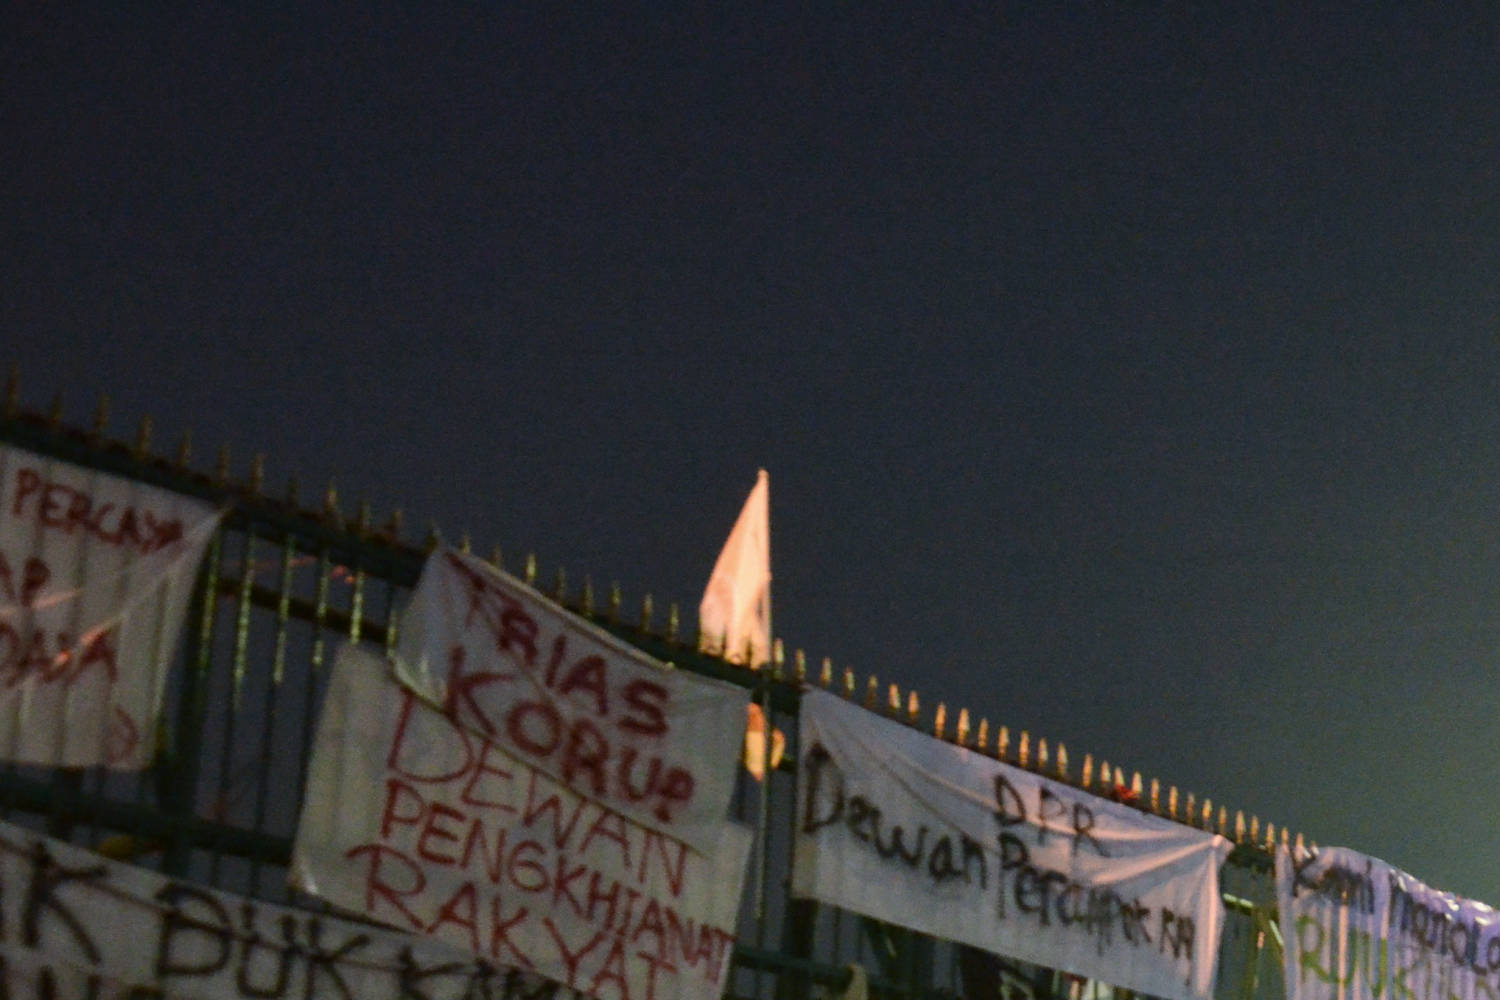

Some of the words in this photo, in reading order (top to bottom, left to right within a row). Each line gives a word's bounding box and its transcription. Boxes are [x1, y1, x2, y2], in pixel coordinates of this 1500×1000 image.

[442, 645, 696, 824] KORUP
[445, 551, 671, 739] TRIAS
[386, 684, 692, 898] DEWAN
[992, 771, 1112, 857] DPR
